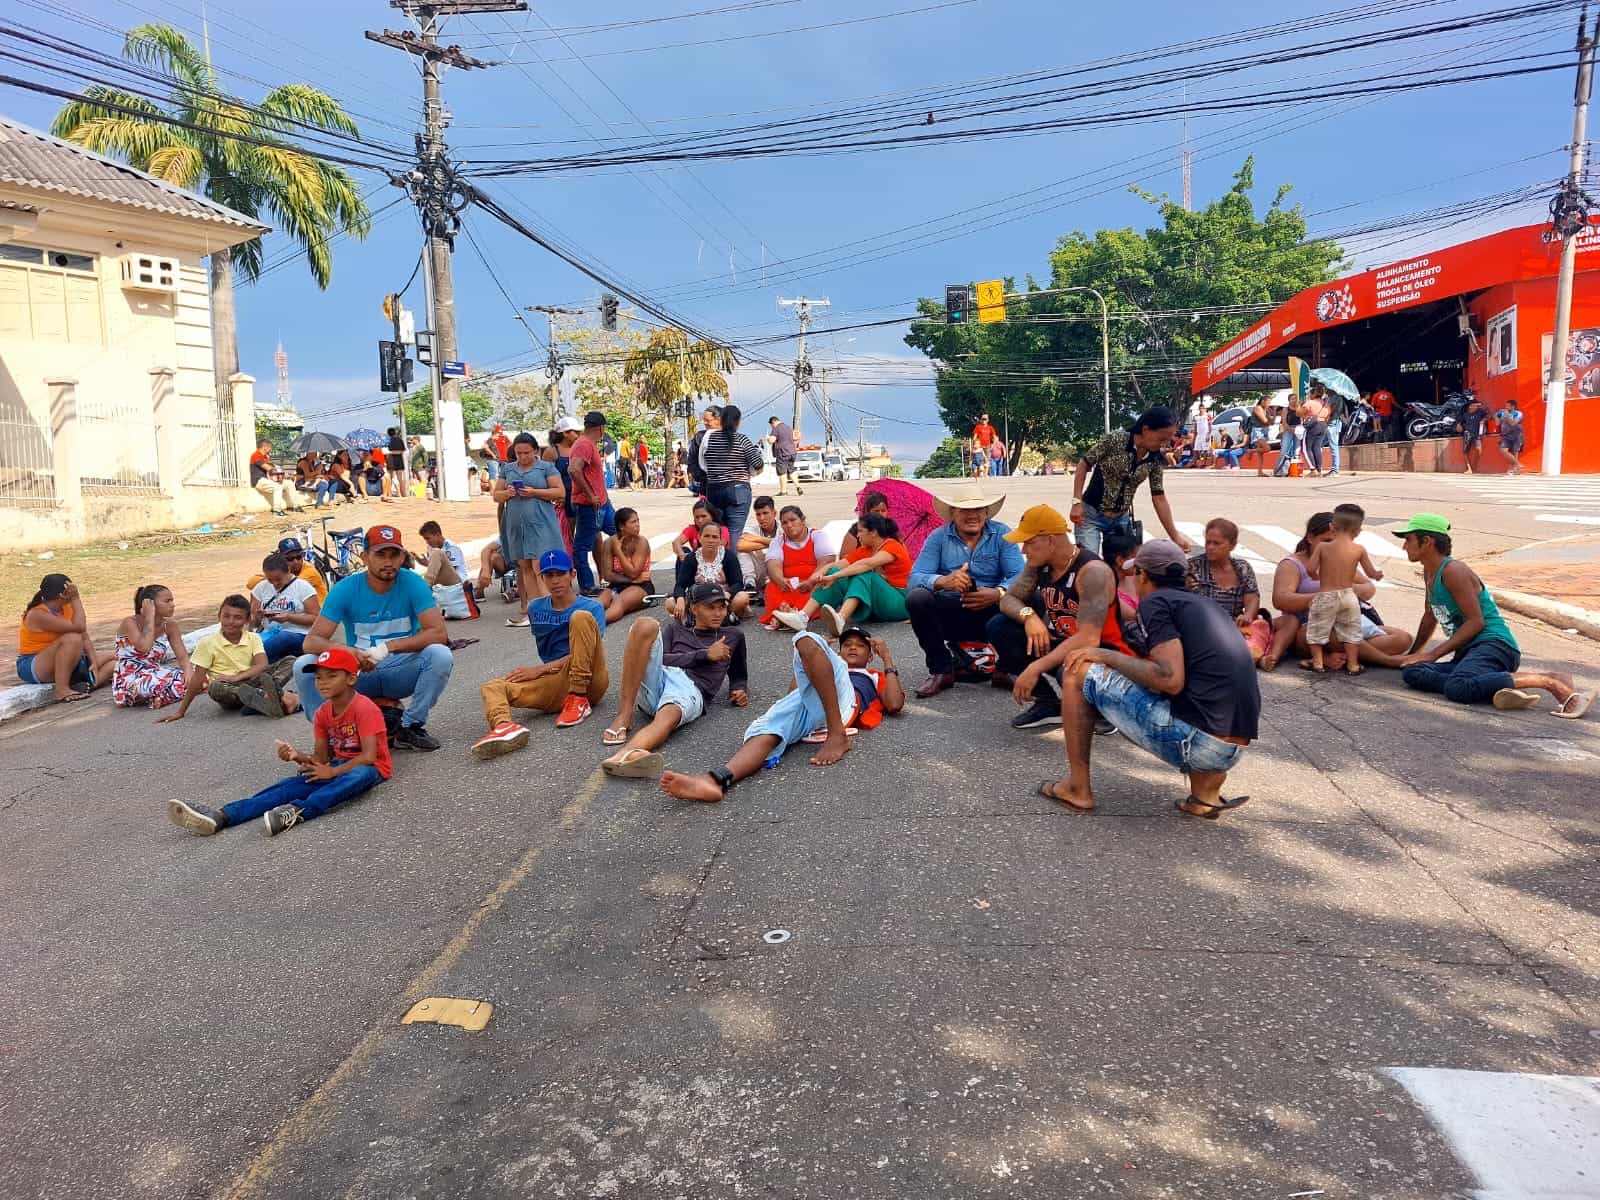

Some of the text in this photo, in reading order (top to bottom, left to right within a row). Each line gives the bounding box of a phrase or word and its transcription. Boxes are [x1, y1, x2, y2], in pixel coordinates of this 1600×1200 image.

[1376, 259, 1429, 279] ALINHAMENTO
[1376, 265, 1442, 290] BALANCEAMENTO
[1376, 277, 1436, 299] TROCA DE ÓLEO
[1376, 291, 1421, 309] SUSPENSÃO
